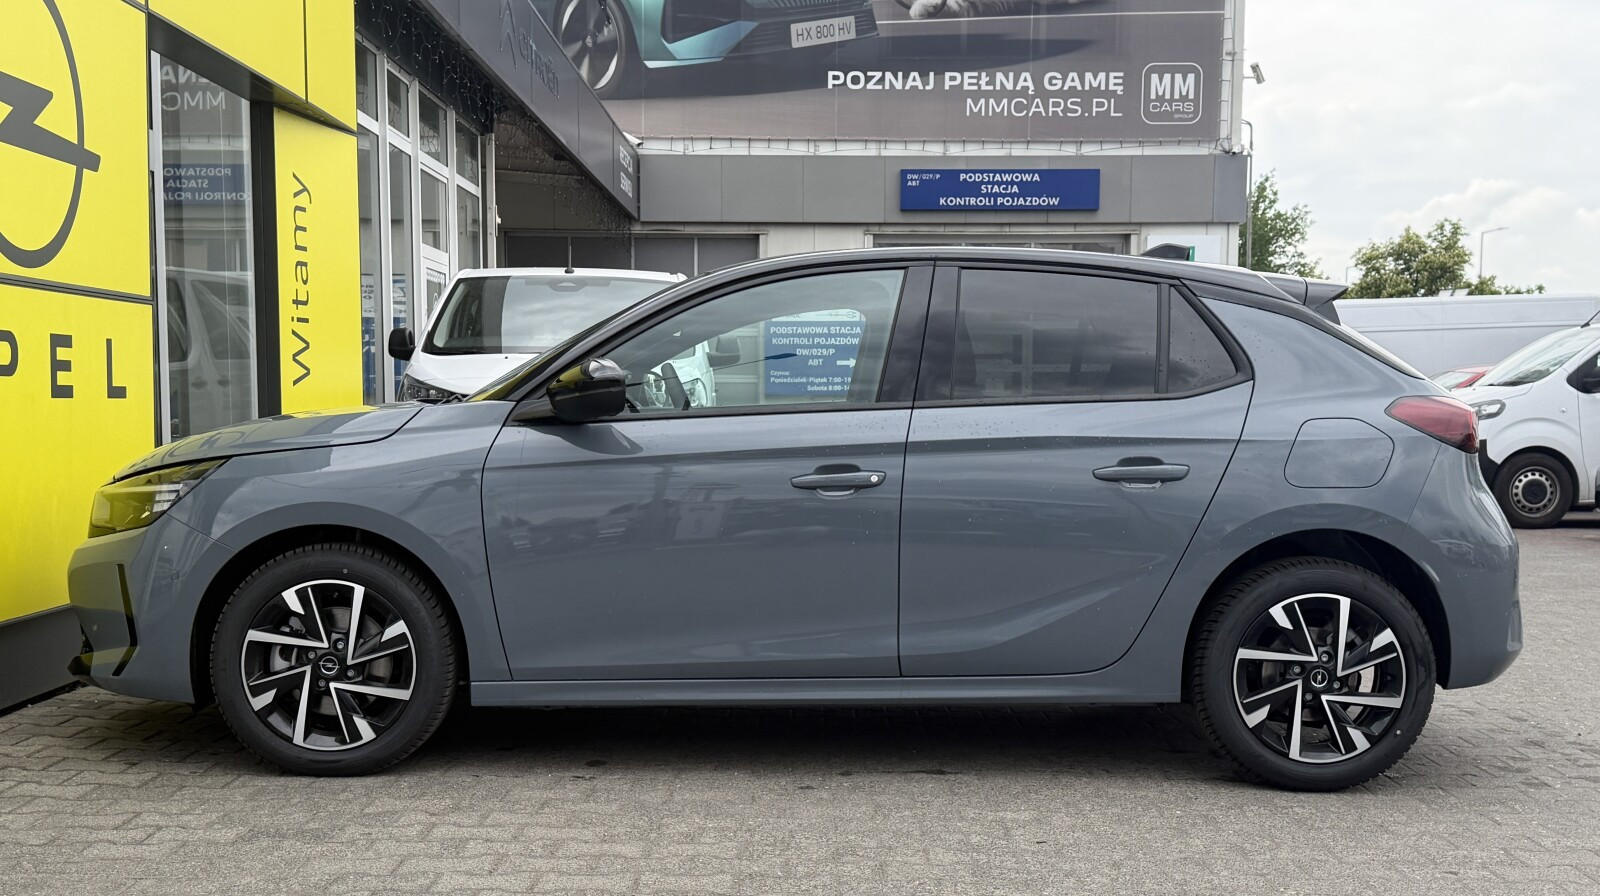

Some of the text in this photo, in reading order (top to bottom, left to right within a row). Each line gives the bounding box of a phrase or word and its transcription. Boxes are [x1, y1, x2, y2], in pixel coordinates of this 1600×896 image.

[796, 21, 852, 42] HX 800 HV
[827, 70, 1124, 95] POZNAJ PEŁNĄ GAMĘ
[1150, 73, 1195, 99] MM
[966, 99, 1123, 117] MMCARS.PL
[1149, 102, 1194, 112] CARS
[959, 173, 1041, 182] PODSTAWOWA
[980, 184, 1019, 194] STACJA
[939, 194, 1060, 206] KONTROLI POJAZDÓW
[292, 171, 313, 386] Witamy
[770, 326, 861, 334] PODSTAWOWA STACJA
[772, 336, 859, 345] KONTROLI POJAZDÓW
[796, 348, 836, 356] DW/029/P
